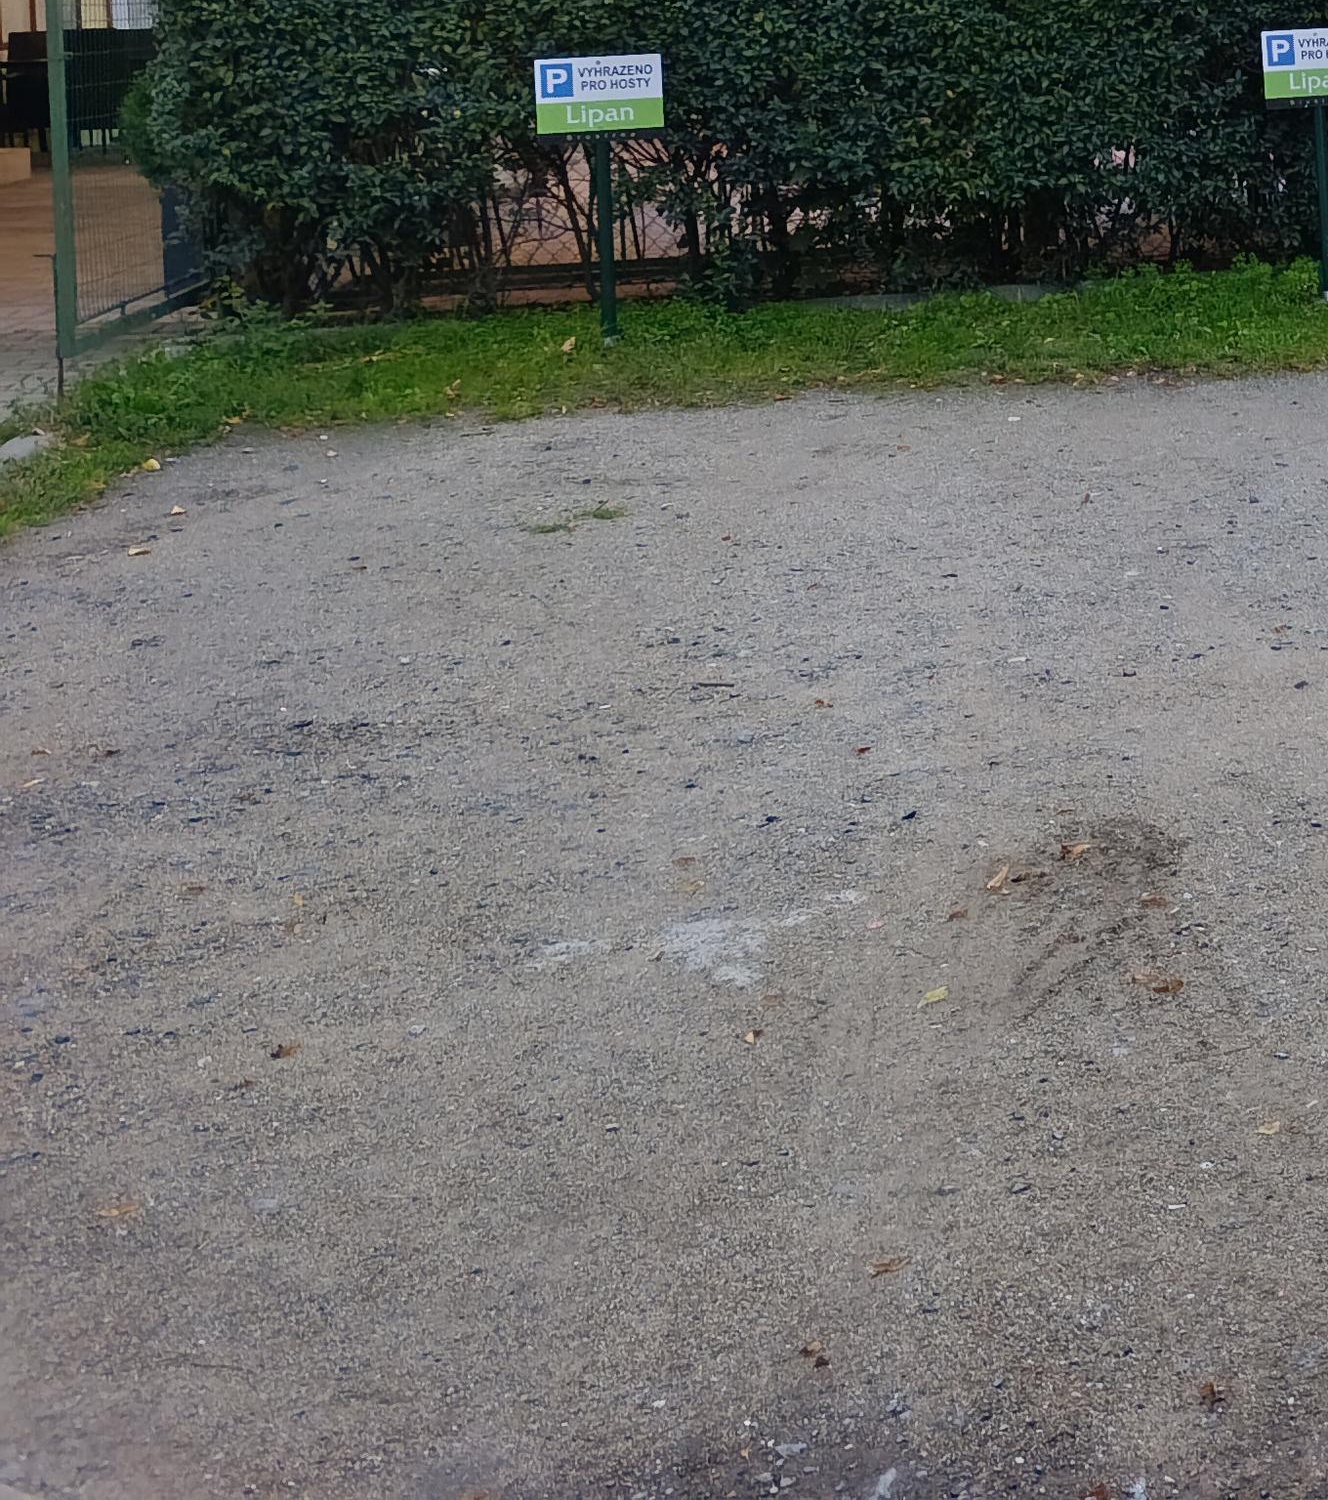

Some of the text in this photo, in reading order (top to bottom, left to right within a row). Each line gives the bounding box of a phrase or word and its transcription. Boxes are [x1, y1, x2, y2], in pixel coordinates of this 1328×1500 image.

[1271, 39, 1291, 63] P
[1301, 49, 1323, 60] PRO
[578, 63, 654, 78] VYHRAZENO
[545, 68, 569, 94] P
[581, 77, 652, 92] PRO HOSTY
[566, 104, 635, 127] Lipan
